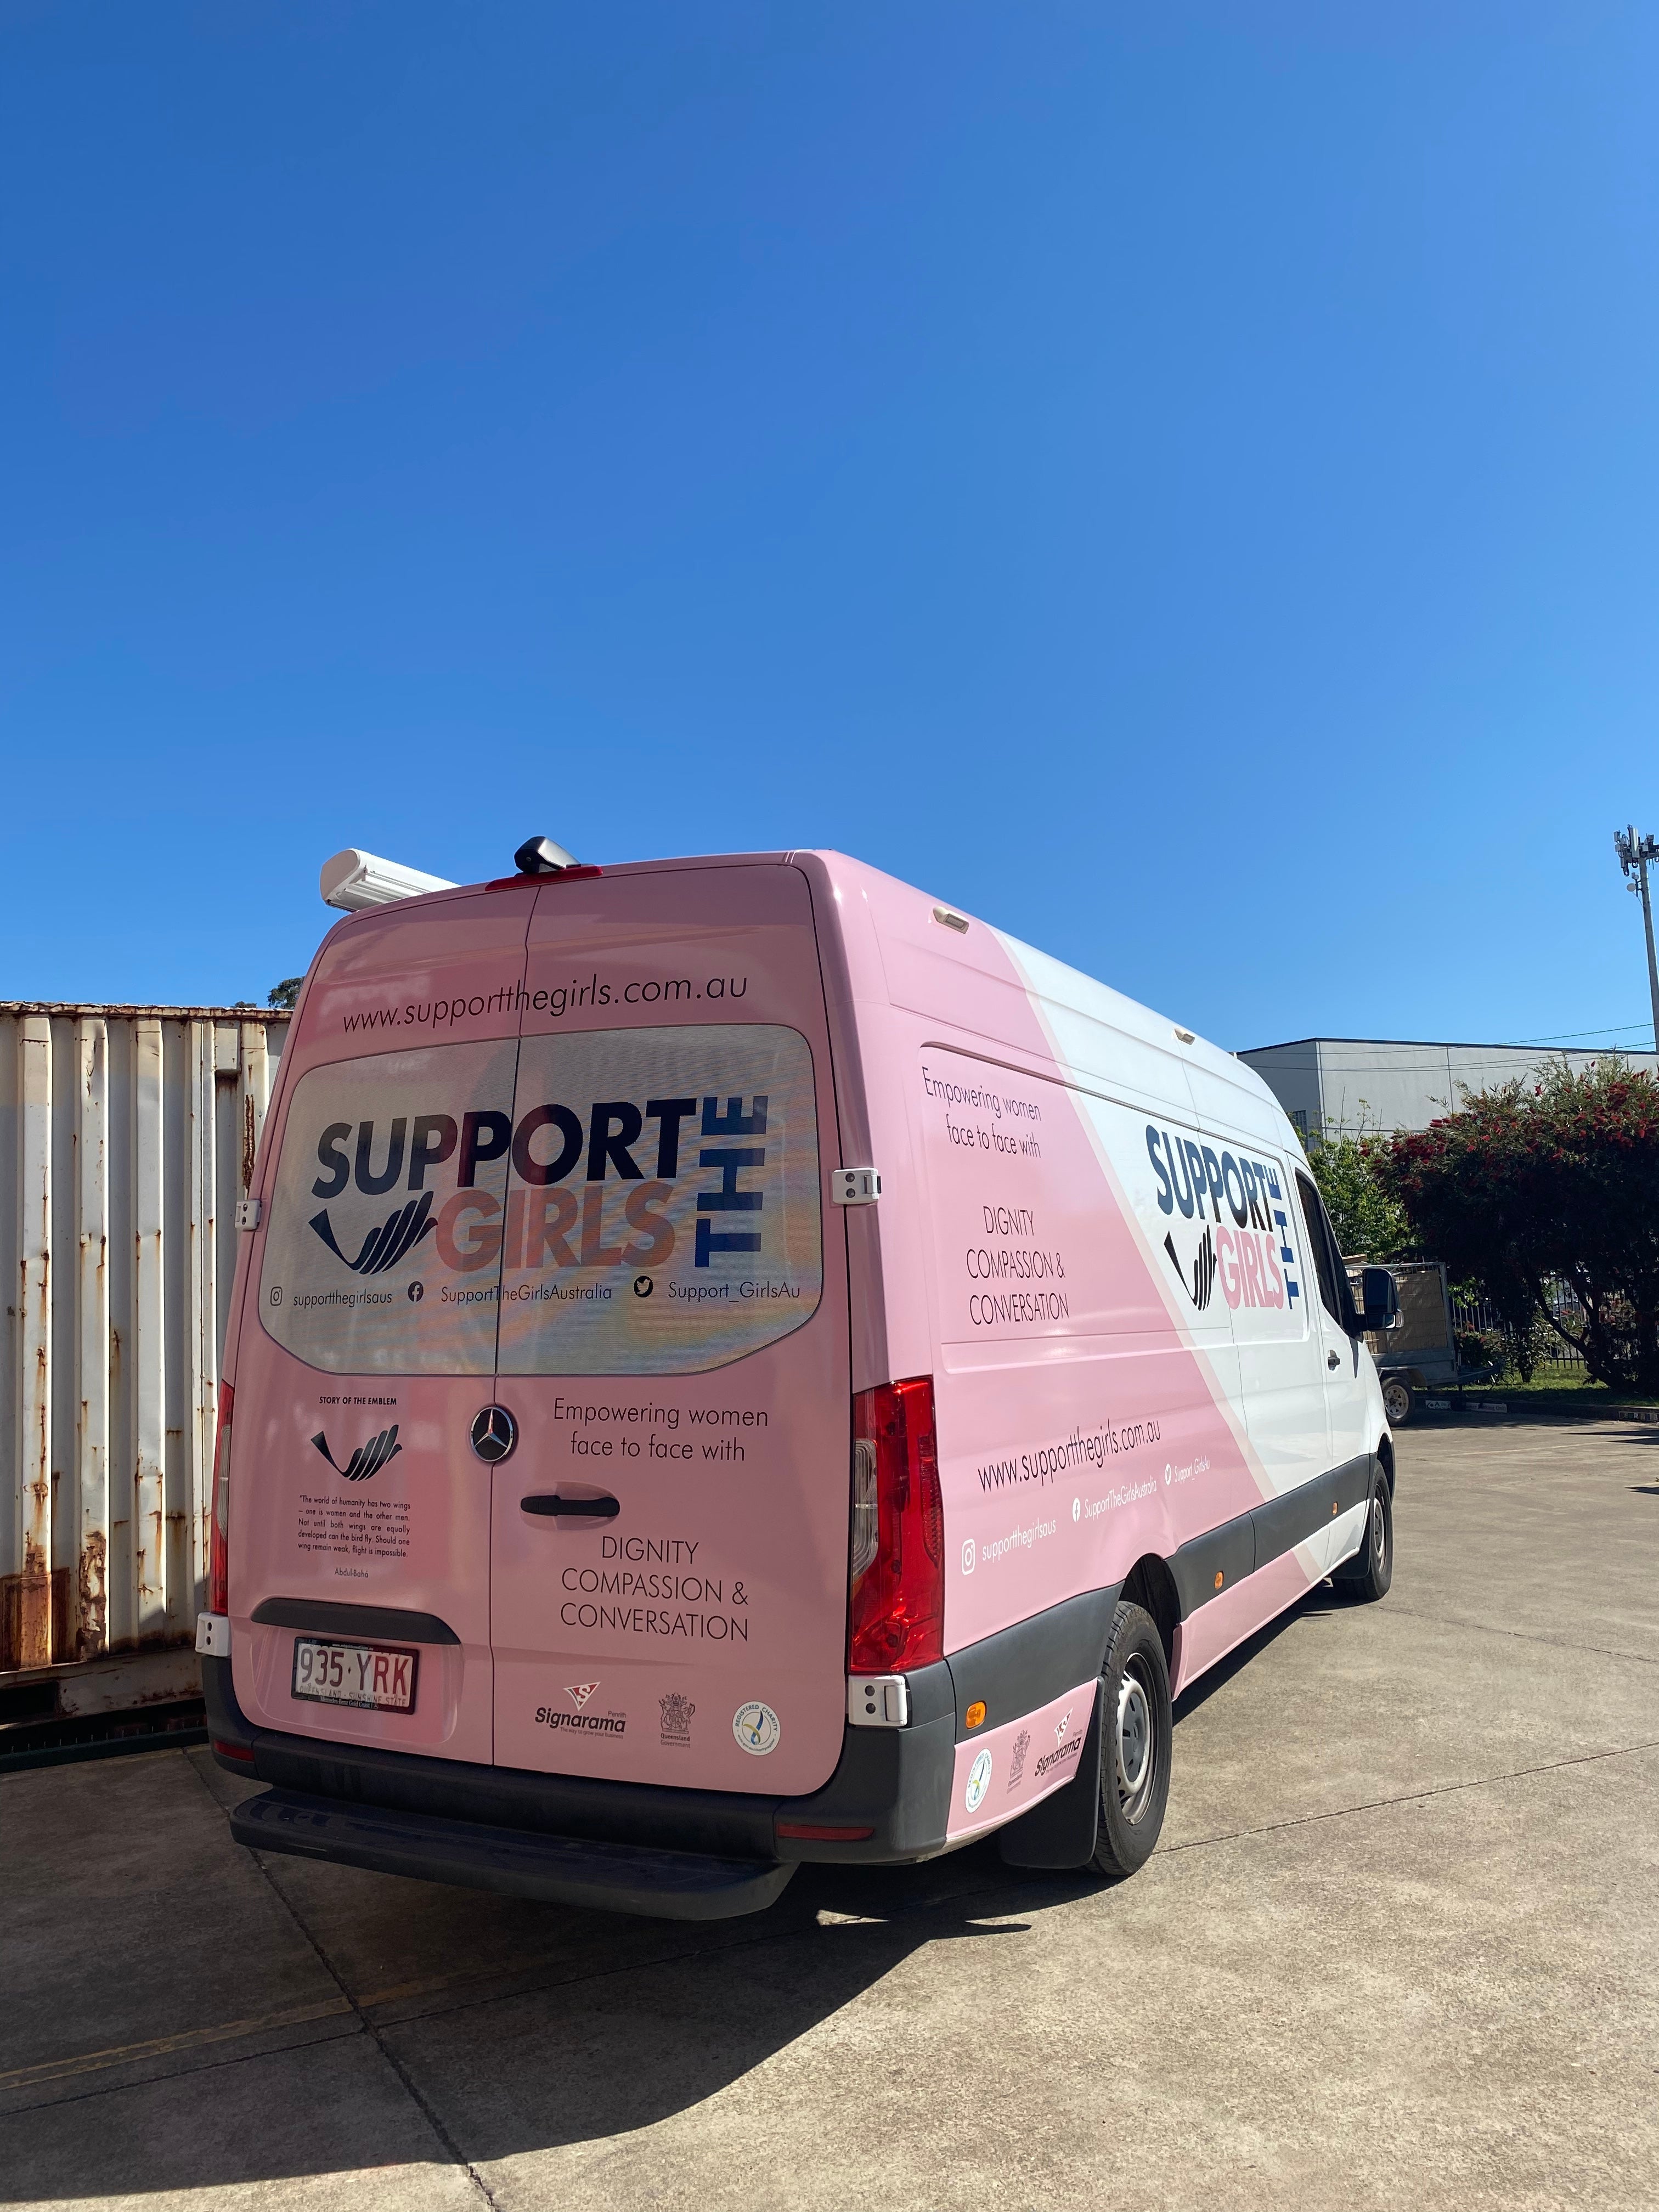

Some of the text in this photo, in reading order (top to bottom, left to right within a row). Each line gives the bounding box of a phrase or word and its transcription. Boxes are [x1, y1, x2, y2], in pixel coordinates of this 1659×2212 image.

[343, 973, 748, 1032] www.supportthegirls.com.au
[922, 1066, 1042, 1121] Empowering women
[310, 1098, 697, 1198] SUPPORT
[946, 1113, 1041, 1159] face to face with
[693, 1096, 768, 1267] THE
[1146, 1125, 1273, 1232] SUPPORT
[436, 1180, 676, 1272] GIRLS
[983, 1206, 1035, 1236] DIGNITY
[1263, 1165, 1300, 1310] THE
[966, 1248, 1065, 1279] COMPASSION &
[1216, 1226, 1284, 1310] GIRLS
[293, 1289, 392, 1309] supportthegirlsaus
[441, 1282, 612, 1305] SupportTheGirlsAustralia
[969, 1292, 1069, 1325] CONVERSATION
[554, 1397, 768, 1430] Empowering women
[571, 1431, 746, 1462] face to face with
[978, 1418, 1161, 1493] www.supportthegirls.com.au
[339, 1497, 365, 1509] humanity
[368, 1498, 377, 1507] has
[393, 1501, 410, 1511] wings
[363, 1510, 373, 1519] the
[376, 1511, 392, 1520] other
[1085, 1478, 1157, 1521] SupportTheGirlsAustralia
[298, 1529, 327, 1541] developed
[340, 1532, 349, 1541] the
[351, 1533, 363, 1542] bird
[375, 1535, 396, 1544] Should
[330, 1519, 343, 1528] both
[349, 1522, 366, 1532] wings
[386, 1525, 410, 1536] equally
[982, 1519, 1056, 1563] supportthegirlsaus
[298, 1542, 311, 1551] wing
[333, 1544, 351, 1554] weak,
[352, 1545, 366, 1556] flight
[602, 1536, 699, 1565] DIGNITY
[561, 1567, 749, 1605] COMPASSION &
[560, 1602, 748, 1641] CONVERSATION
[300, 1648, 408, 1695] 935 YRK
[349, 1692, 381, 1704] SUNSHINE
[386, 1697, 407, 1707] STATE
[535, 1707, 626, 1732] Signarama
[735, 1705, 777, 1731] REGISTERED CHARITY
[661, 1733, 690, 1741] Queensland
[661, 1740, 690, 1748] Government
[1035, 1737, 1081, 1776] Signarama
